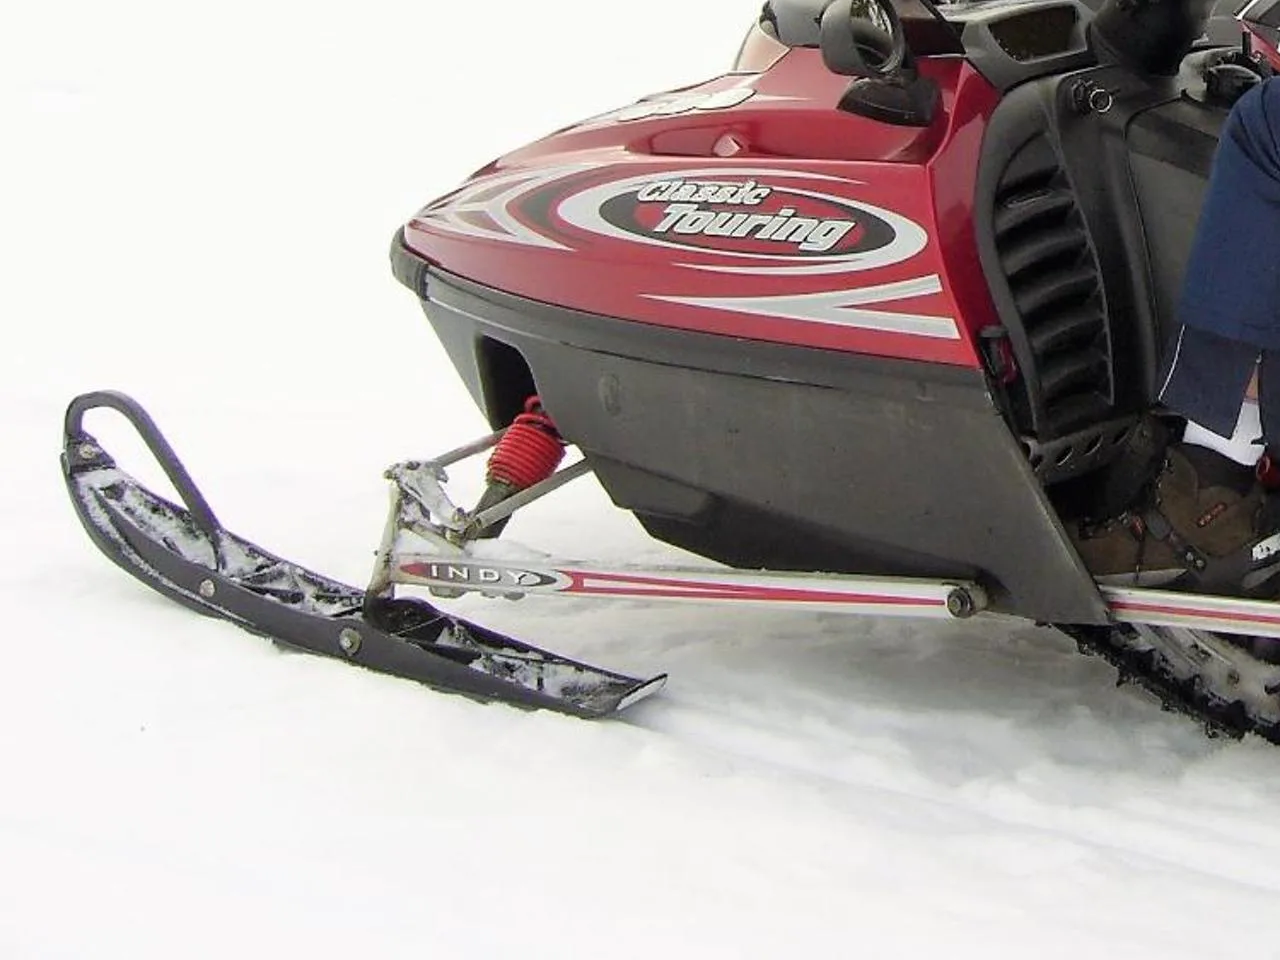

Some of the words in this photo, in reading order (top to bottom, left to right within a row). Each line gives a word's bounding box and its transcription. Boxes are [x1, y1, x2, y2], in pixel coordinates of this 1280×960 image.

[637, 179, 772, 206] Classic
[653, 203, 856, 253] Touring
[430, 564, 531, 586] INDY
